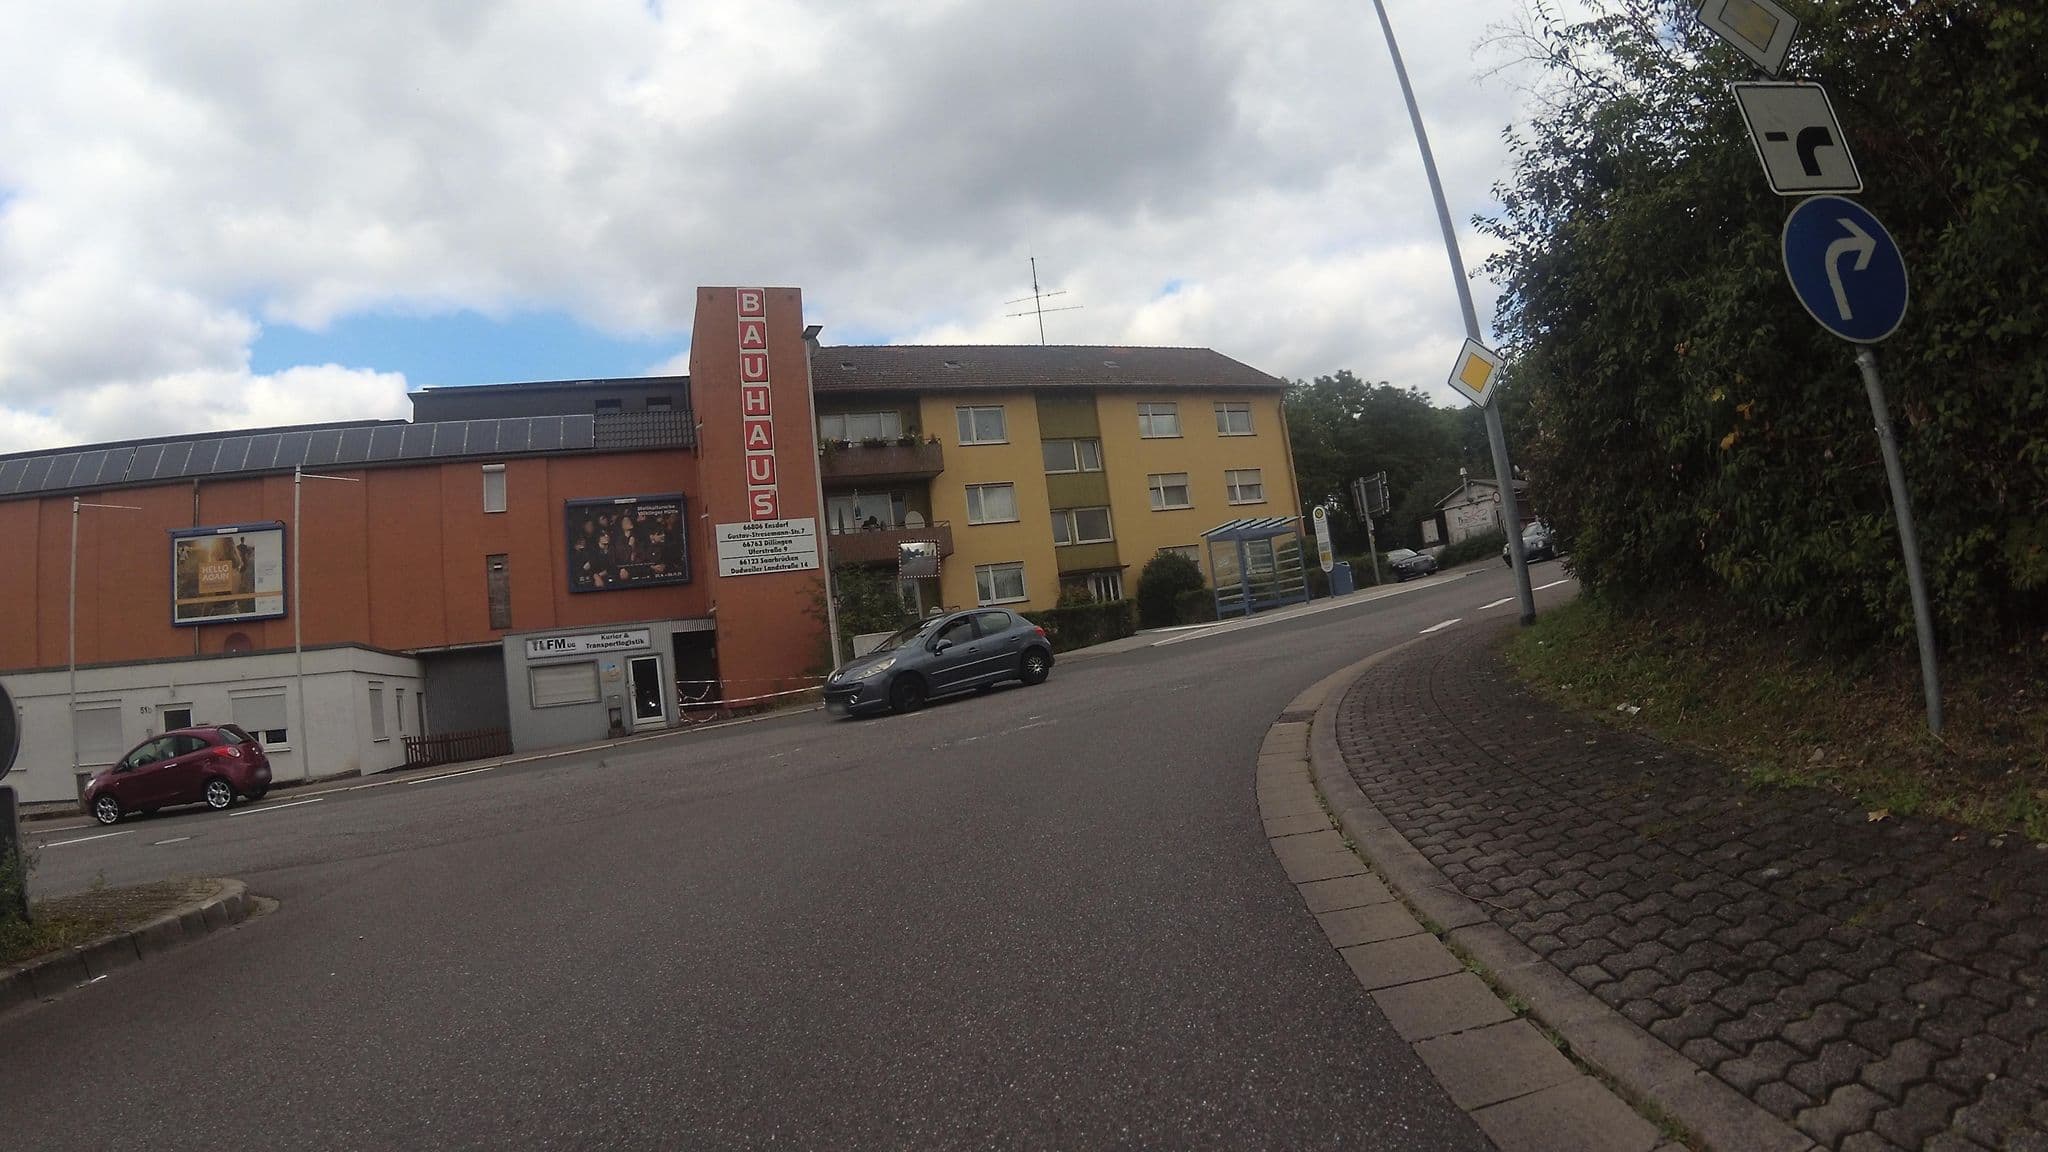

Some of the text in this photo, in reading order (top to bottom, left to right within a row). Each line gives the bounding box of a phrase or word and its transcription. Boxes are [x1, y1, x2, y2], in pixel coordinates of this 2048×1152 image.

[742, 293, 773, 515] BAUHAUS
[764, 521, 789, 529] Ensdorf
[742, 538, 793, 548] 66763 Dillingen
[748, 546, 782, 555] Uferstraße
[760, 555, 799, 563] Saarbrücken
[202, 564, 229, 574] HELLO
[730, 565, 762, 574] Dudweiler
[764, 562, 799, 571] Landstraße
[585, 638, 645, 649] Transportlogistik
